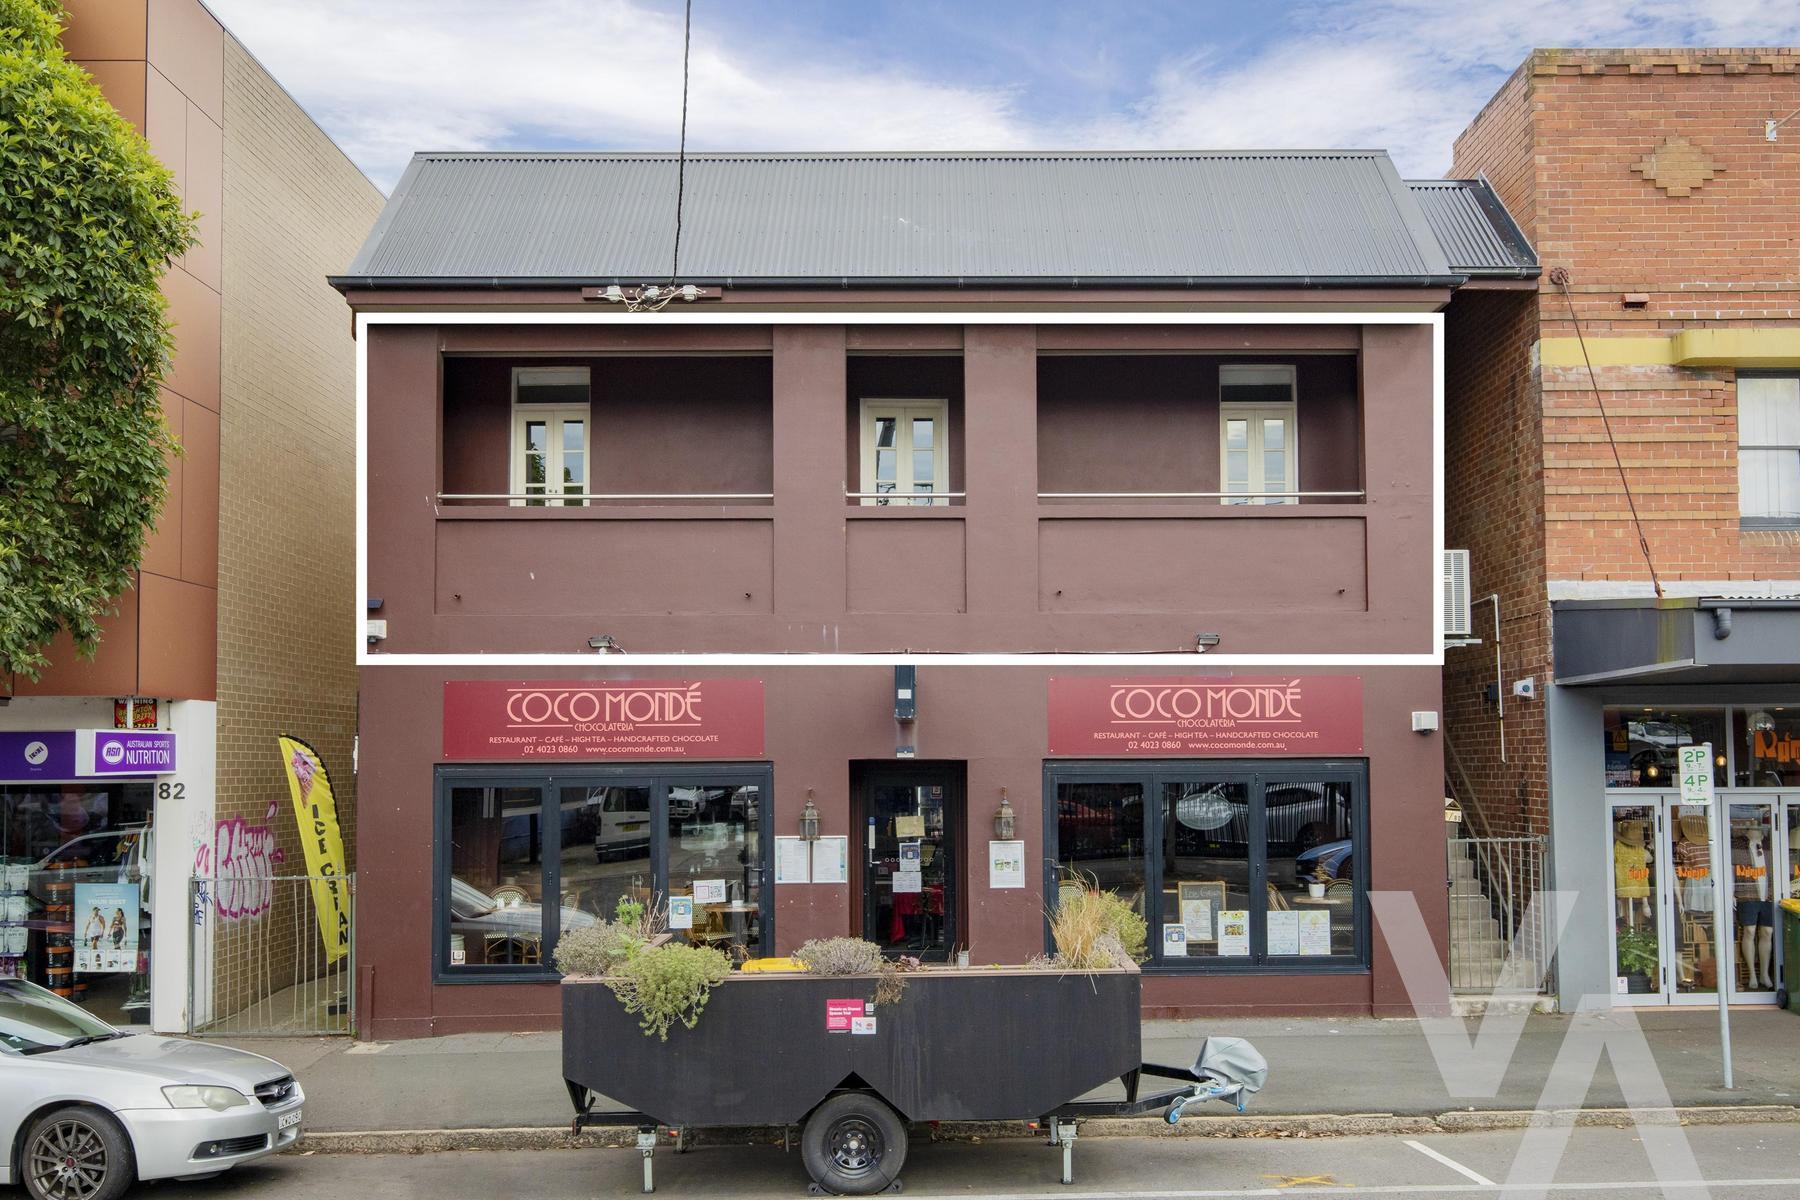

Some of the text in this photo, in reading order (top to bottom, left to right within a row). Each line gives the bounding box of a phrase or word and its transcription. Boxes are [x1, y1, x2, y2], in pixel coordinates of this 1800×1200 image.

[507, 681, 702, 722] COCO MONDÉ
[1110, 679, 1302, 719] COCO MONDÉ
[574, 722, 634, 732] CHOCOLATERIA
[1176, 719, 1236, 728] CHOCOLATERIA
[488, 736, 538, 744] RESTAURANT
[544, 735, 564, 743] CAFÉ
[571, 735, 591, 743] HIGH
[591, 735, 606, 743] TEA
[613, 735, 670, 743] HANDCRAFTED
[671, 734, 719, 743] CHOCOLATE
[1093, 731, 1140, 739] RESTAURANT
[1148, 730, 1167, 739] CAFÉ
[1174, 731, 1194, 739] HIGH
[1194, 731, 1209, 739] TEA
[1215, 731, 1271, 739] HANDCRAFTED
[1272, 731, 1319, 739] CHOCOLATE
[126, 740, 170, 748] AUSTRALIAN SPORTS
[1128, 741, 1285, 749] 02 4023 0860 www.cocomonde.com.au
[523, 745, 685, 754] 02 4023 0860 www.cocomonde.com.au
[126, 750, 170, 765] NUTRITION
[1684, 751, 1706, 762] 2P
[1684, 775, 1708, 787] 4P
[158, 783, 186, 800] 82
[311, 803, 328, 855] ICE
